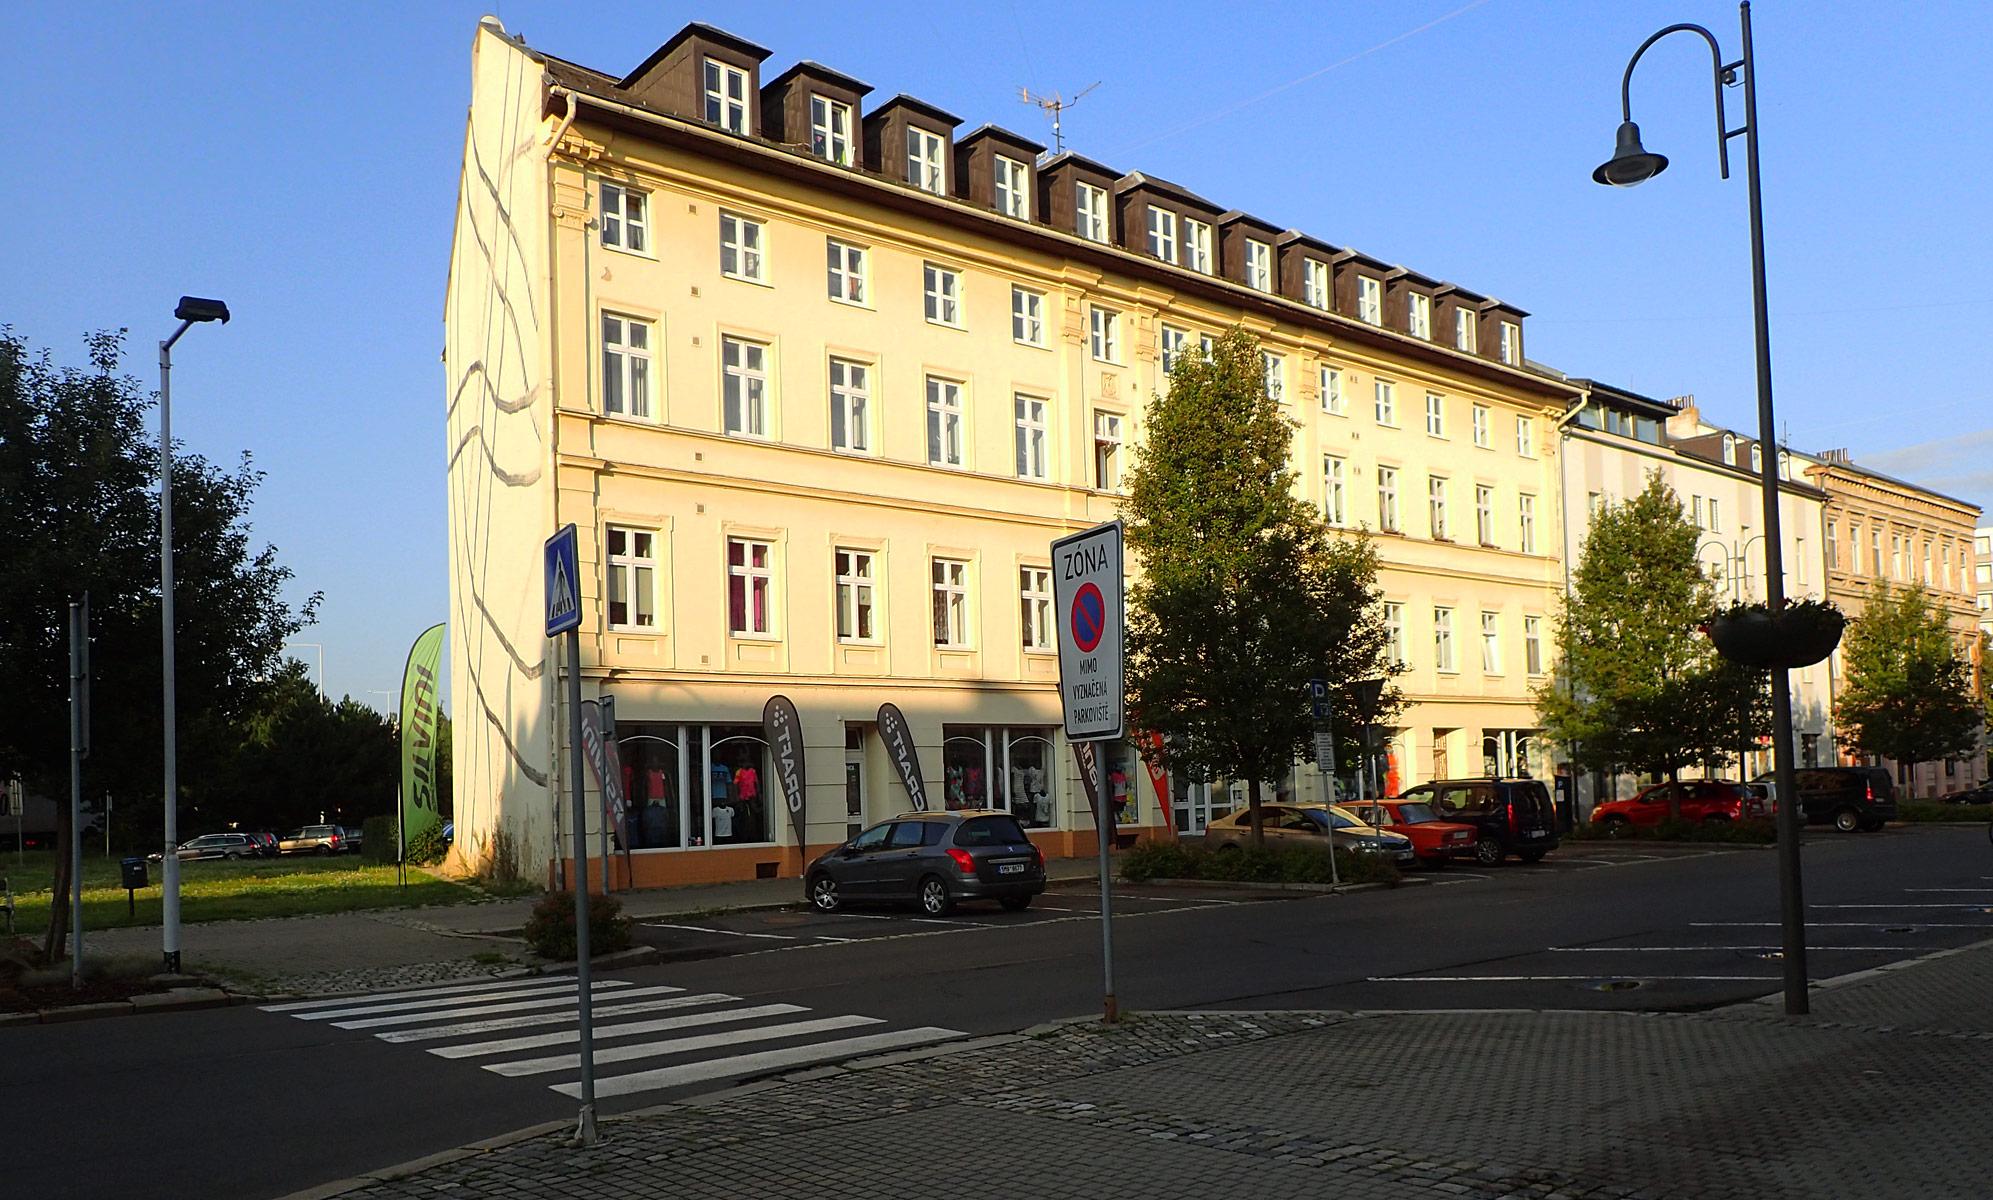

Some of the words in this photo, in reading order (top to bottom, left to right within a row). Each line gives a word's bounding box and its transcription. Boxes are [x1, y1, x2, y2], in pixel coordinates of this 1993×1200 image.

[1064, 543, 1108, 580] ZÓNA
[1079, 657, 1097, 675] MIMO
[1072, 676, 1108, 700] VYZNAČENÁ
[1073, 703, 1109, 724] PARKOVIŠTĚ
[412, 664, 433, 811] SILVINI
